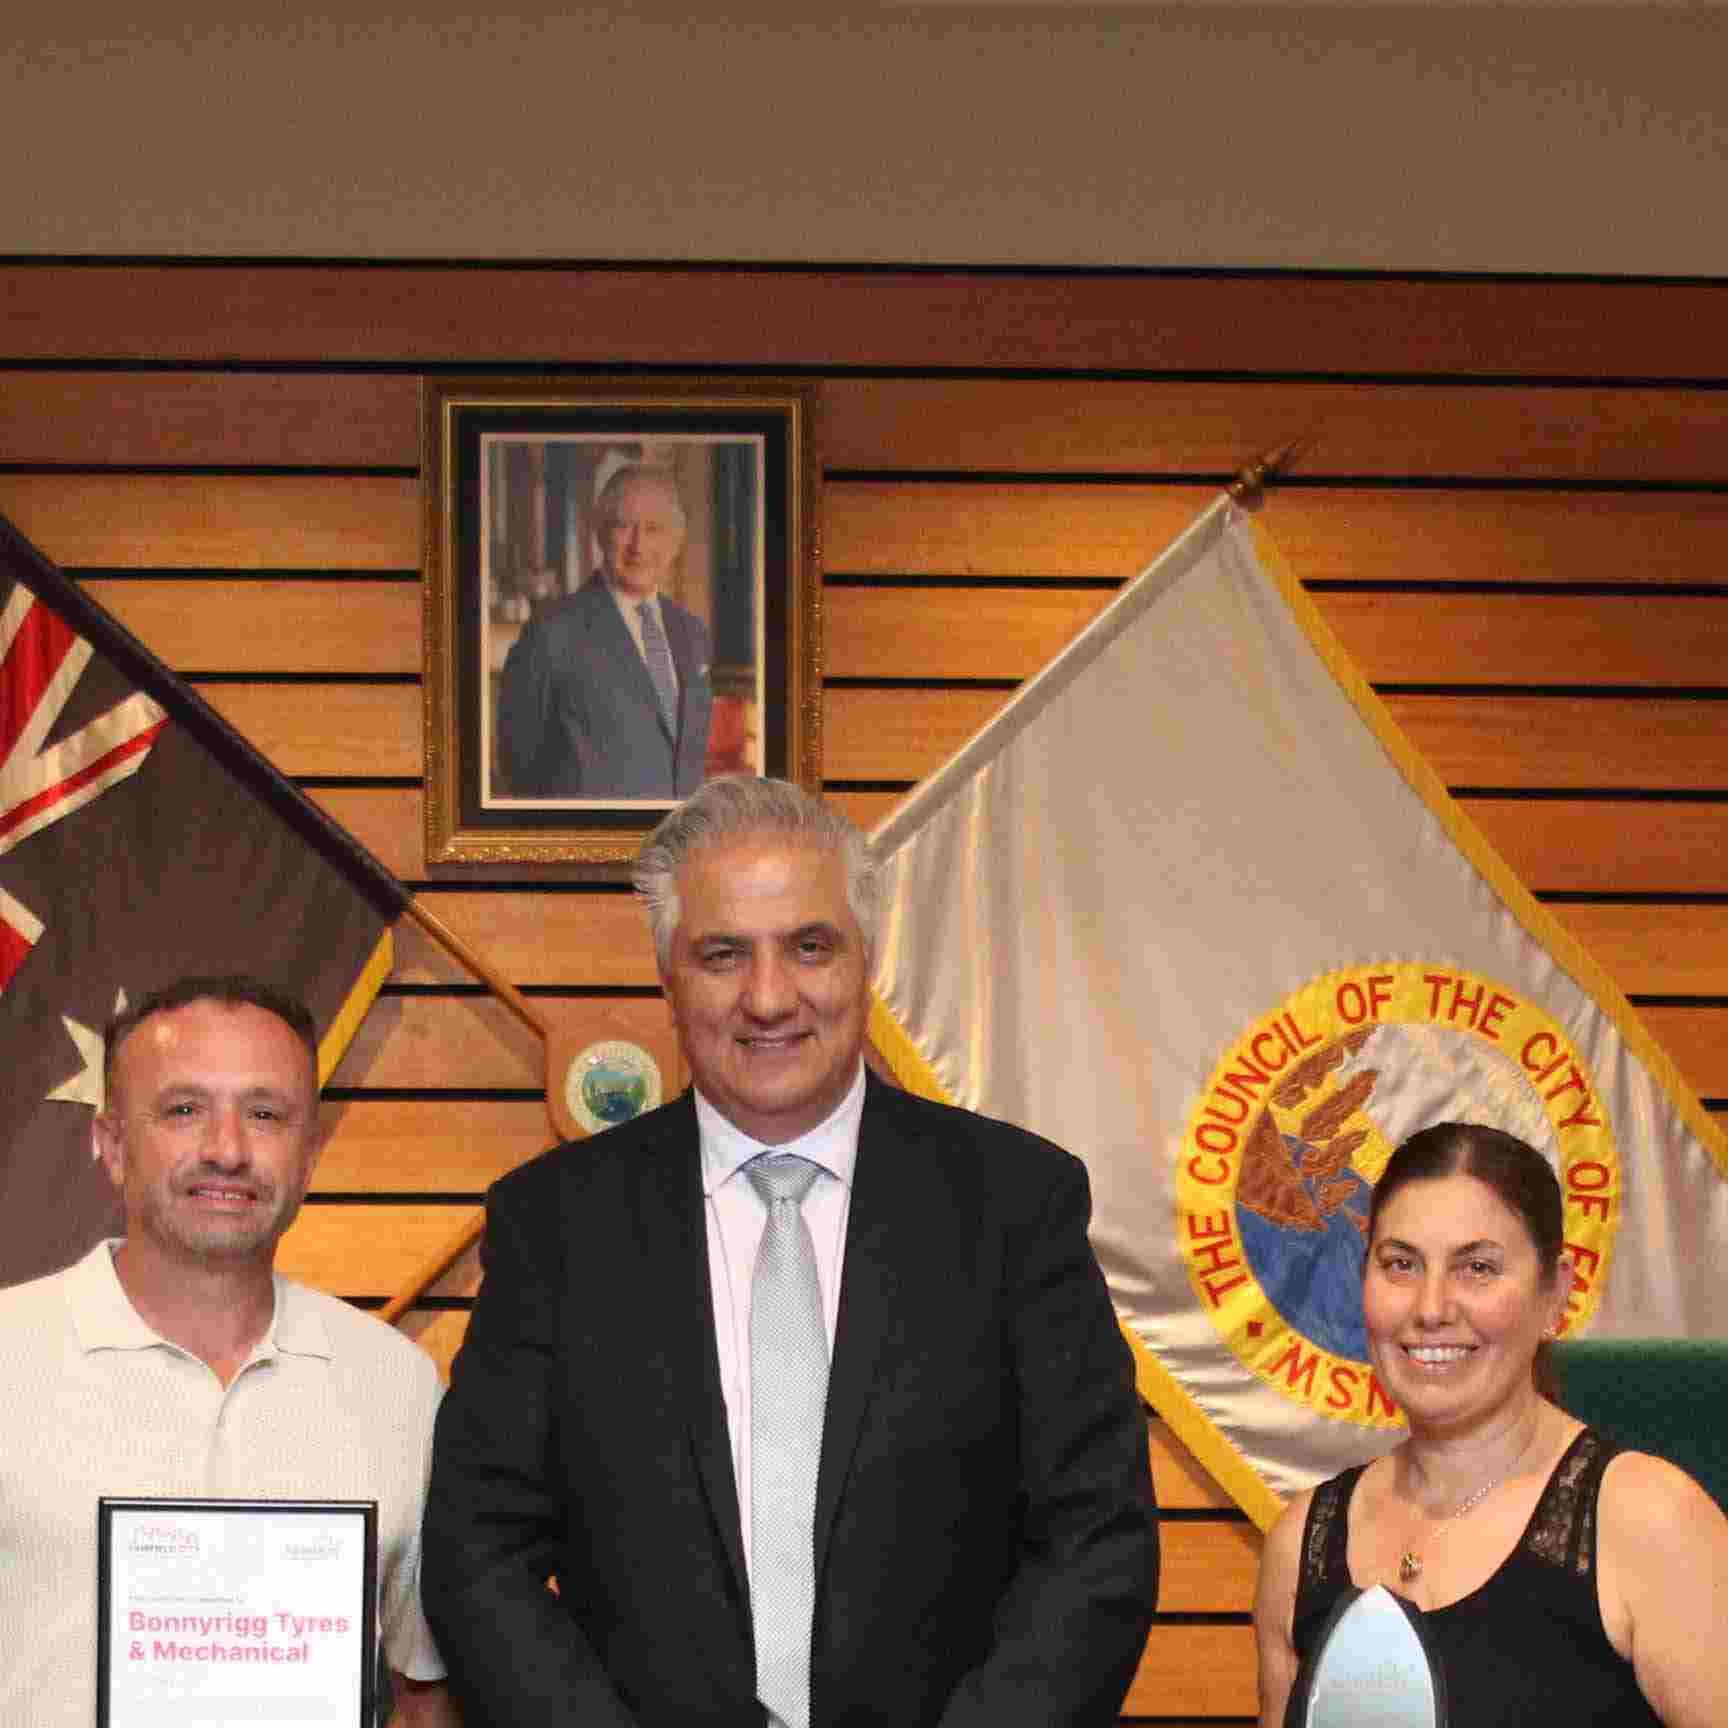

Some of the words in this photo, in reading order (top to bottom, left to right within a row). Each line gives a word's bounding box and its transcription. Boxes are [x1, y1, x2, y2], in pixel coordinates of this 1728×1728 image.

[1336, 975, 1394, 1024] OF
[1422, 973, 1516, 1041] THE
[1188, 1014, 1323, 1185] COUNCIL
[1520, 1032, 1602, 1130] CITY
[1568, 1161, 1610, 1223] OF
[1189, 1210, 1248, 1307] THE
[128, 1611, 268, 1637] Bonnyrigg
[274, 1612, 350, 1637] Tyres
[128, 1641, 146, 1662] &
[153, 1641, 310, 1663] Mechanical
